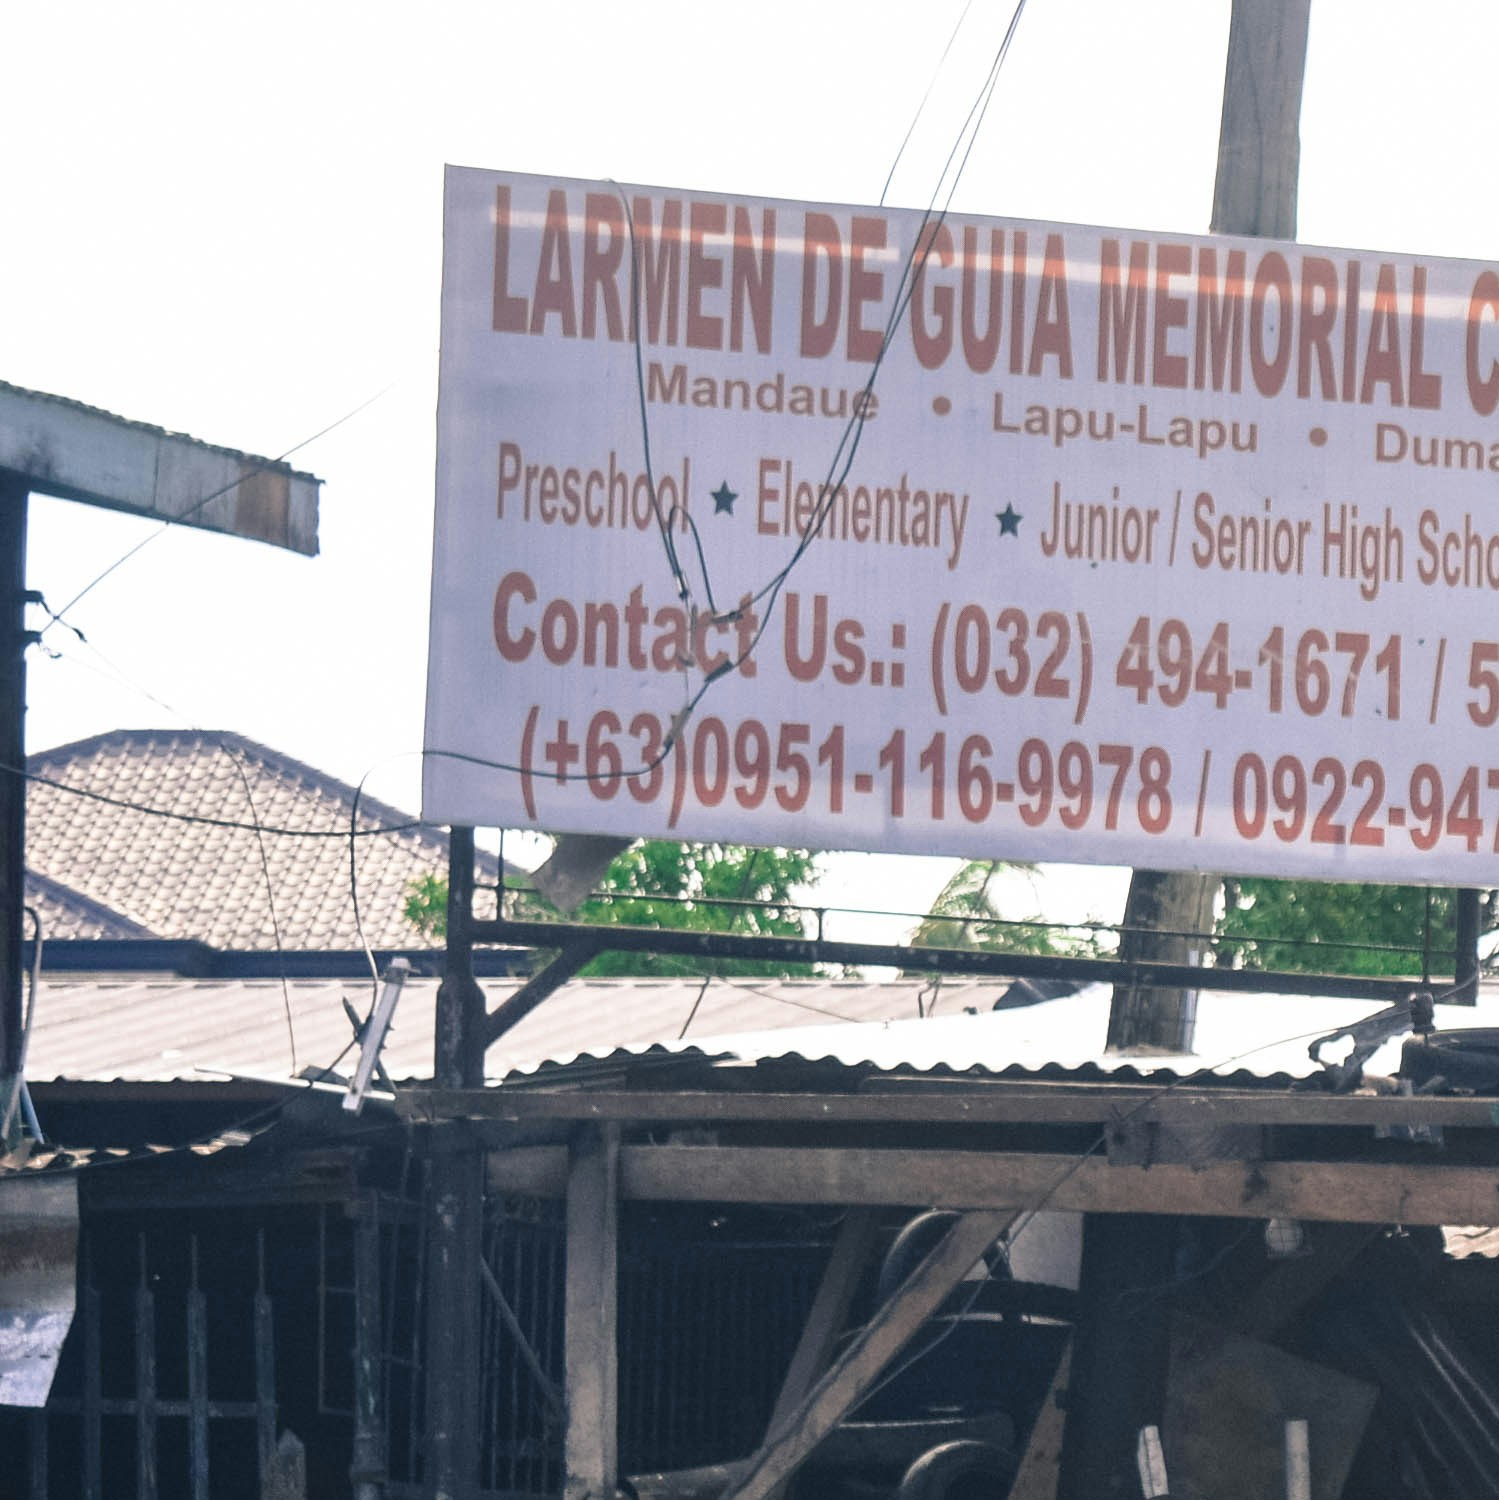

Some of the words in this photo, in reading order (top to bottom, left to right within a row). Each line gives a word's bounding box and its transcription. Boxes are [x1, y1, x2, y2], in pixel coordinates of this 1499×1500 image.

[491, 184, 778, 356] LARMEN
[797, 210, 888, 363] DE
[910, 221, 1073, 380] GUIA
[1096, 237, 1443, 411] MEMORIAL
[646, 361, 880, 422] Mandaue
[993, 391, 1260, 458] Lapu-Lapu
[496, 442, 691, 534] Preschool
[757, 457, 970, 570] Elementary
[1041, 481, 1159, 566] Junior
[1168, 491, 1182, 567] /
[1192, 491, 1311, 577] Senior
[1322, 502, 1403, 602] High
[492, 570, 759, 680] Contact
[783, 592, 905, 688] Us.:
[931, 601, 1093, 725] (032)
[1116, 615, 1402, 721] 494-1671
[1430, 637, 1447, 724] /
[520, 704, 1173, 834] (+63)0951-116-9978
[1195, 749, 1211, 836] /
